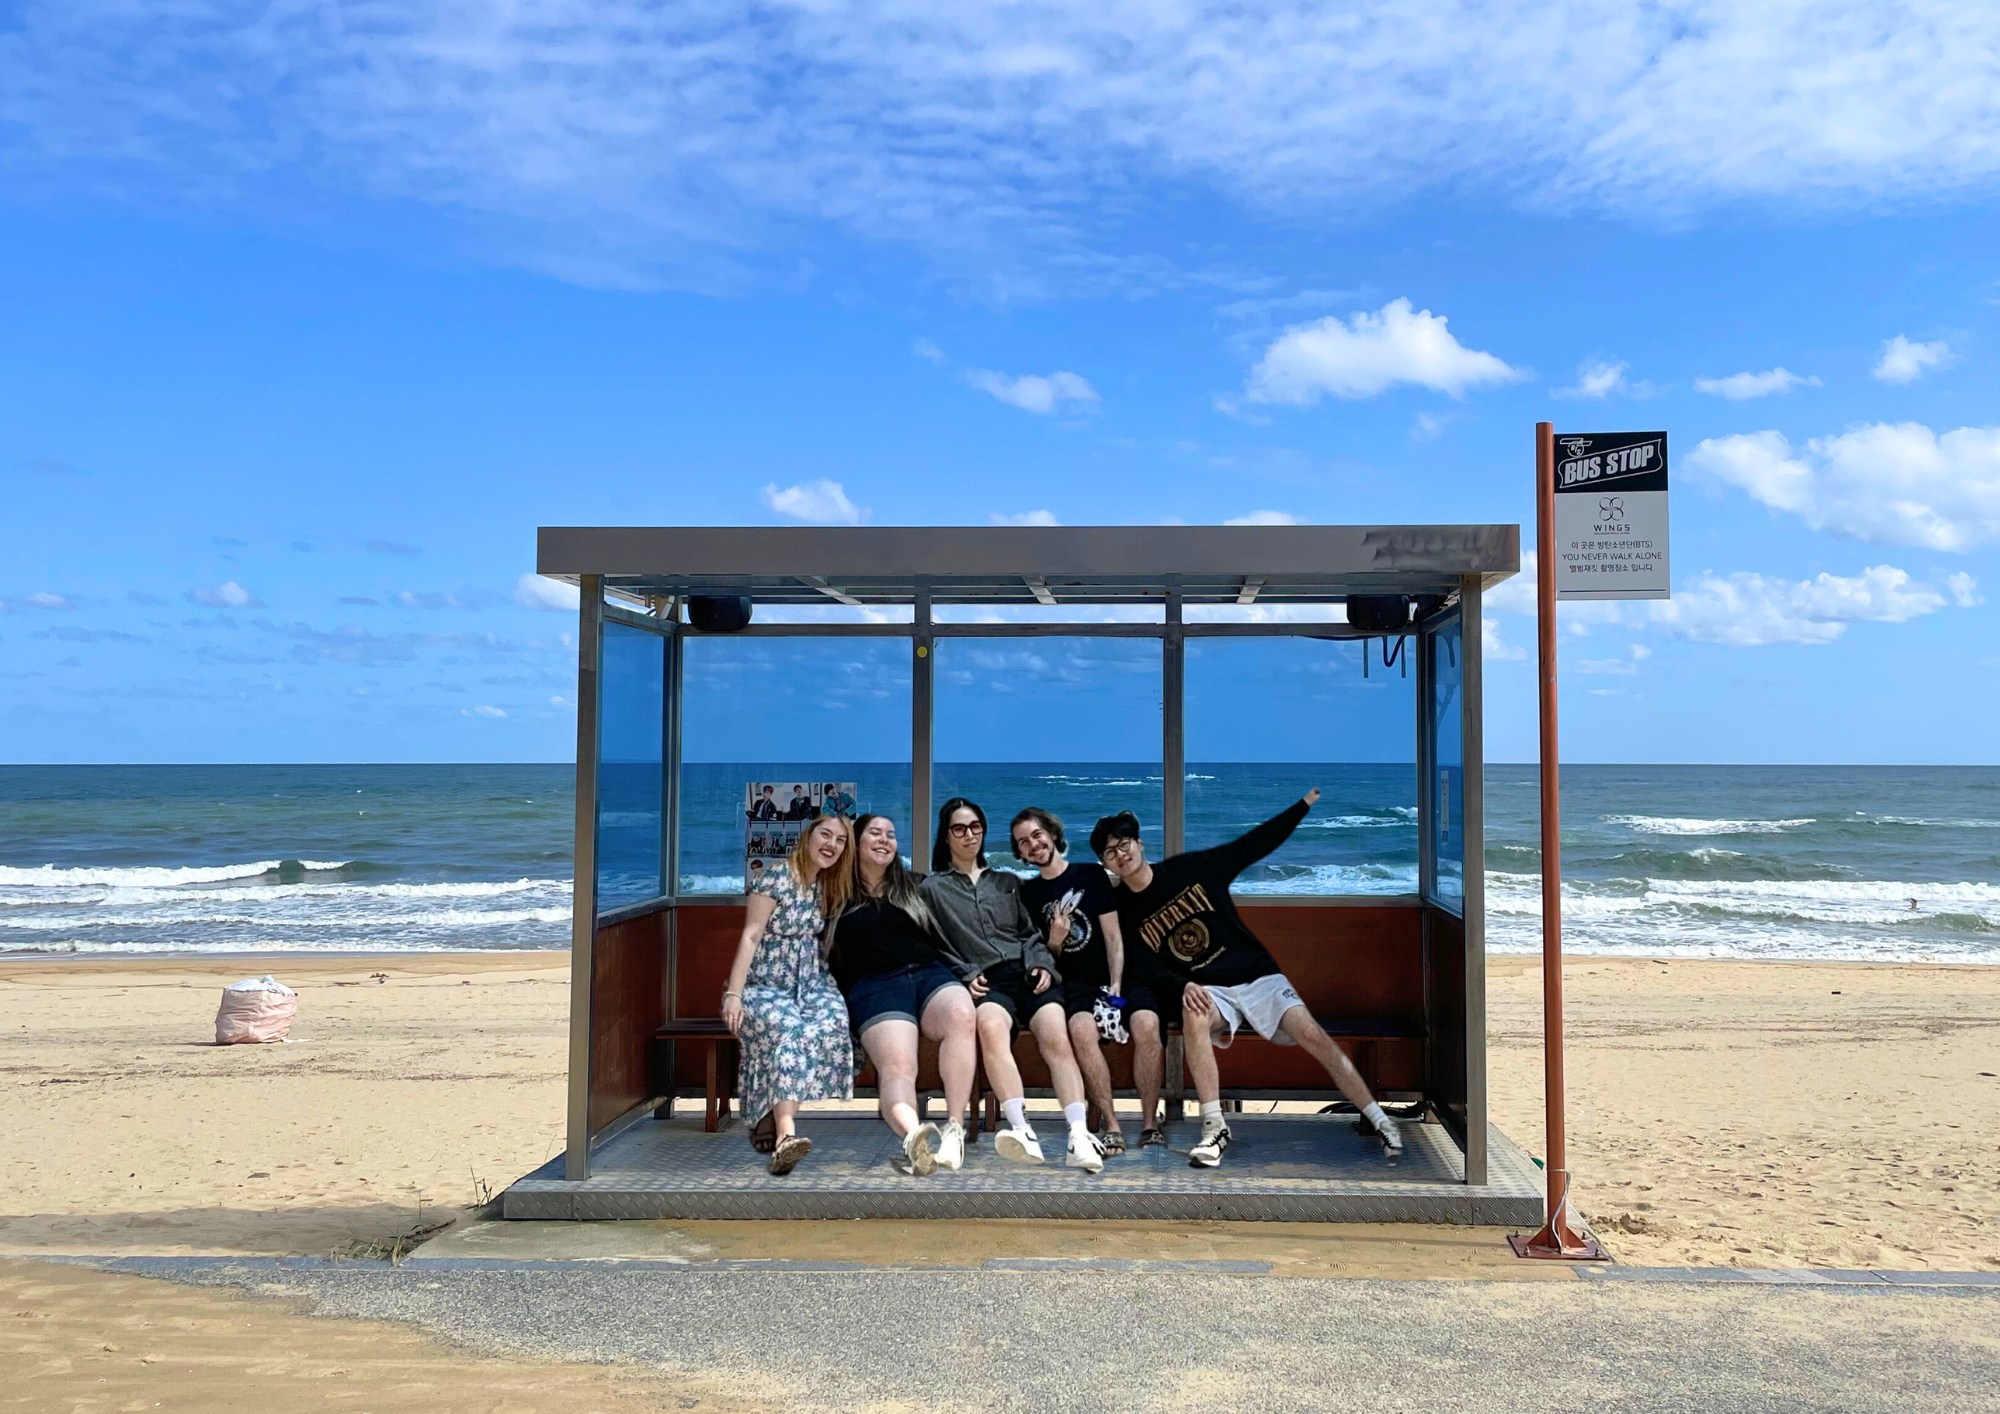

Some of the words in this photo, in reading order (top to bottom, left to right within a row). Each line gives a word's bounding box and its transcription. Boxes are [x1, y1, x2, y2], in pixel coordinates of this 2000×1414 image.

[1564, 457, 1601, 485] BUS
[1606, 444, 1654, 475] STOP
[1593, 524, 1631, 532] WINGS
[1571, 541, 1579, 549] 이
[1581, 541, 1595, 550] 곳은
[1562, 553, 1580, 561] YOU
[1610, 552, 1633, 560] WALK
[1635, 552, 1663, 560] ALONE
